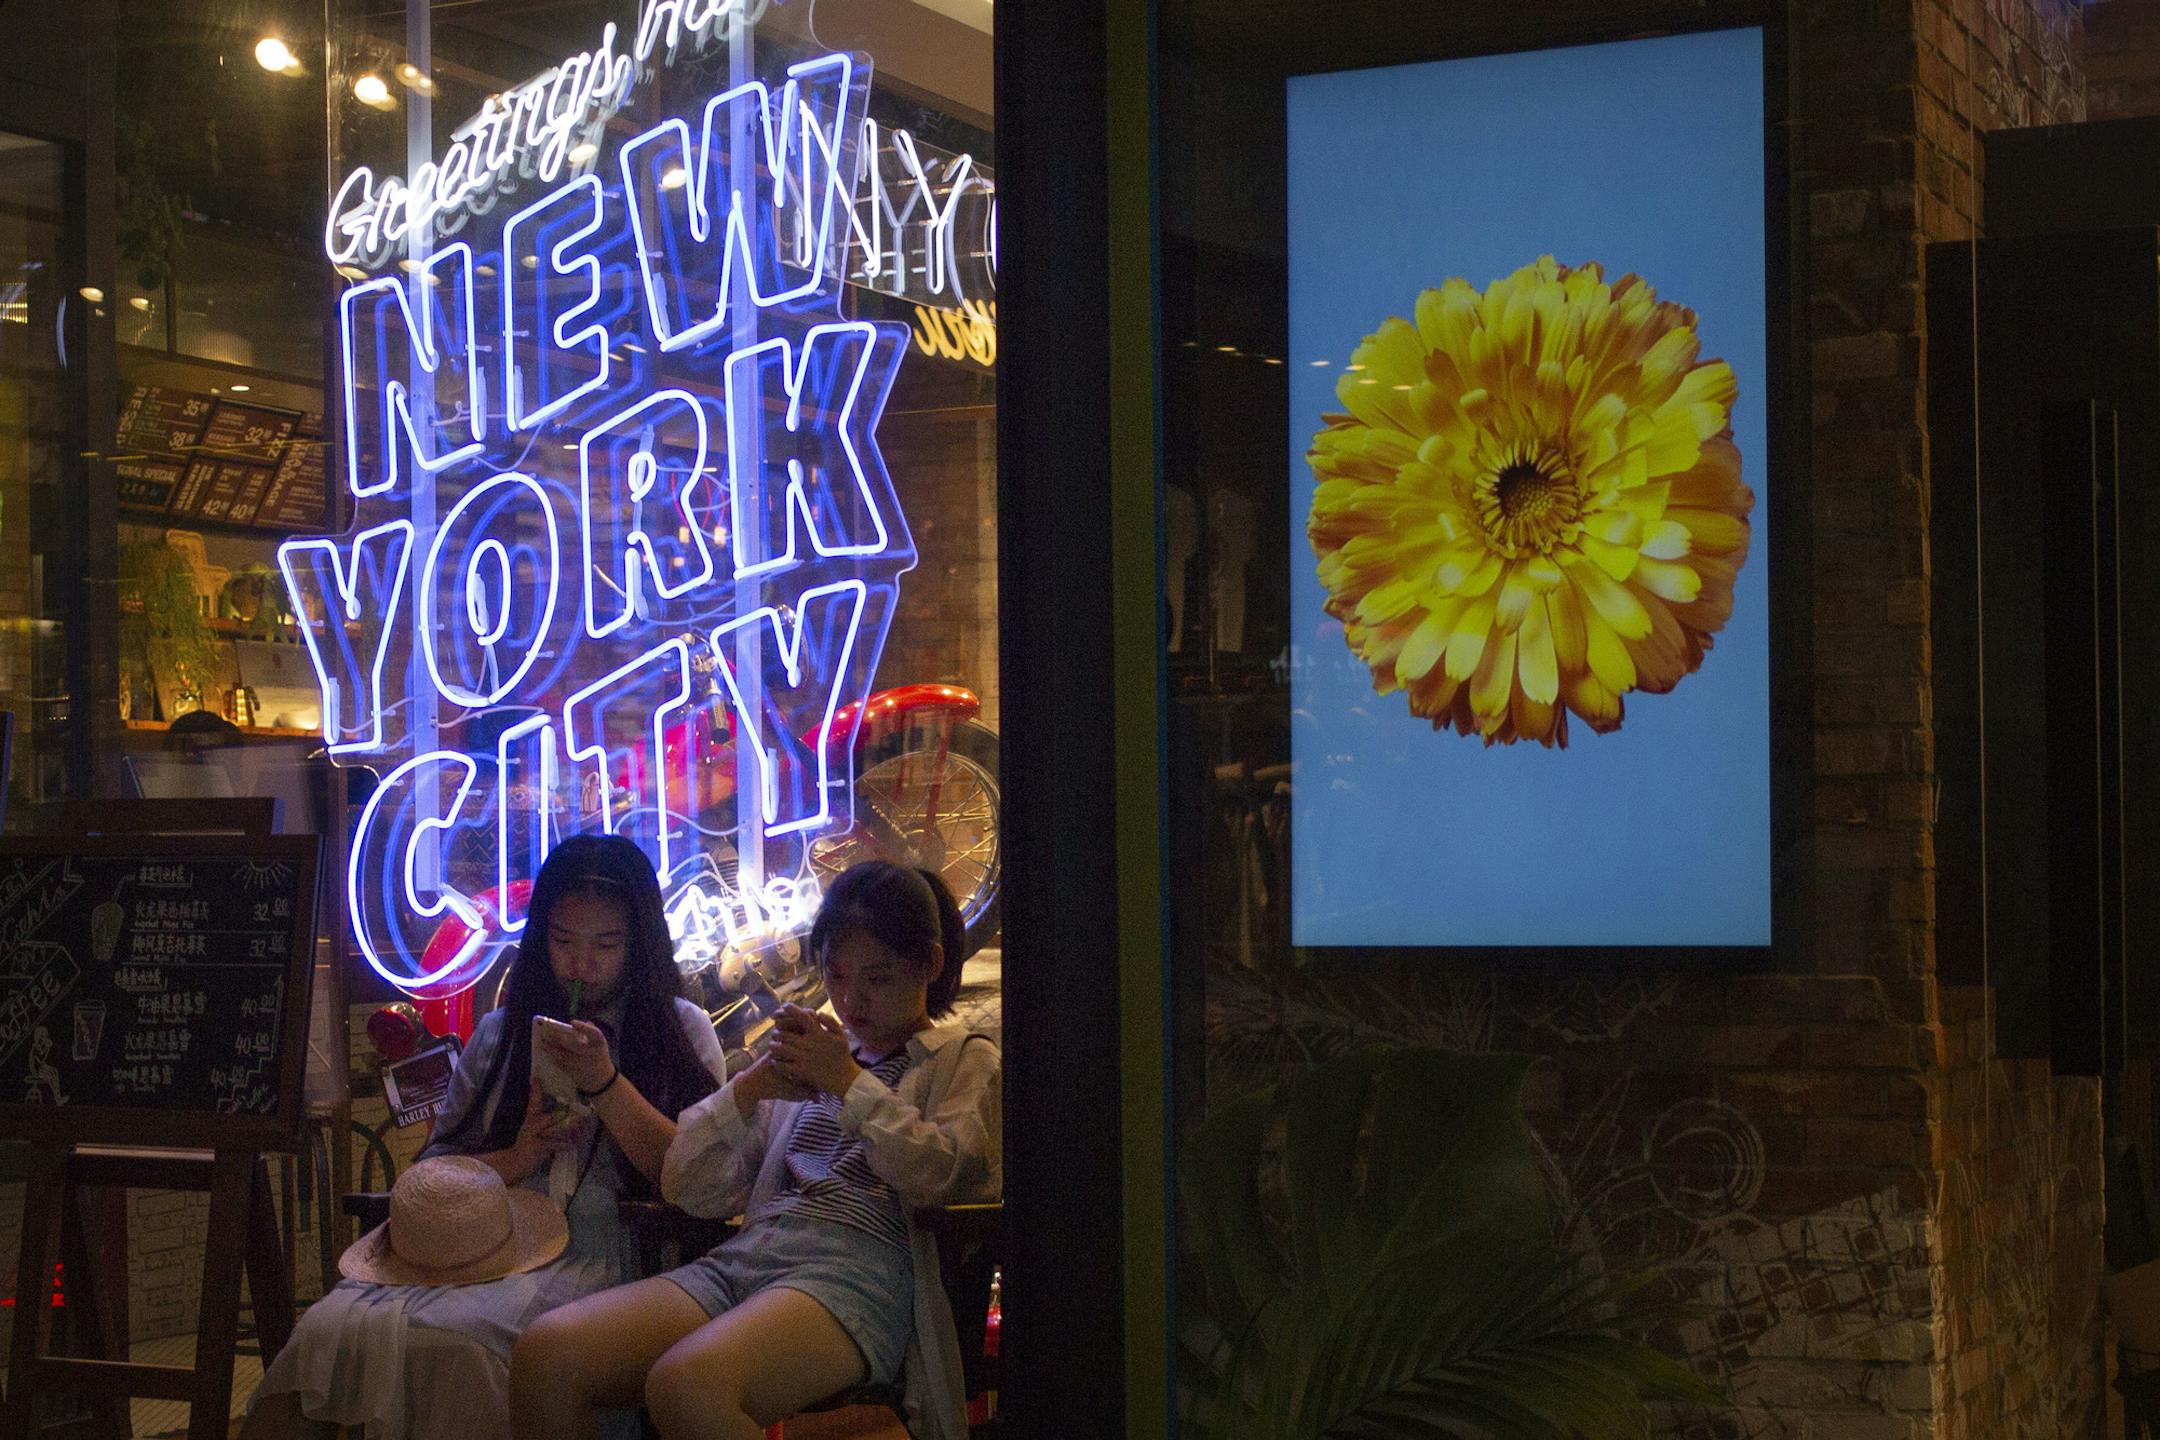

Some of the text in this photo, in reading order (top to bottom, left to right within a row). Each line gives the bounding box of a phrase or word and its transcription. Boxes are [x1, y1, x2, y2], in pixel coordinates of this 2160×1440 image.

[325, 22, 632, 263] Greetings
[797, 100, 996, 294] NY
[340, 52, 852, 498] NEW
[169, 431, 186, 447] 38
[244, 425, 264, 442] 32
[202, 499, 221, 516] 42
[230, 504, 248, 519] 40
[277, 320, 888, 754] YORK
[348, 580, 867, 988] CITY
[252, 902, 271, 922] 32
[241, 997, 258, 1018] 40
[235, 1033, 252, 1056] 40
[210, 1067, 227, 1090] 40
[397, 1105, 431, 1127] HARLEY
